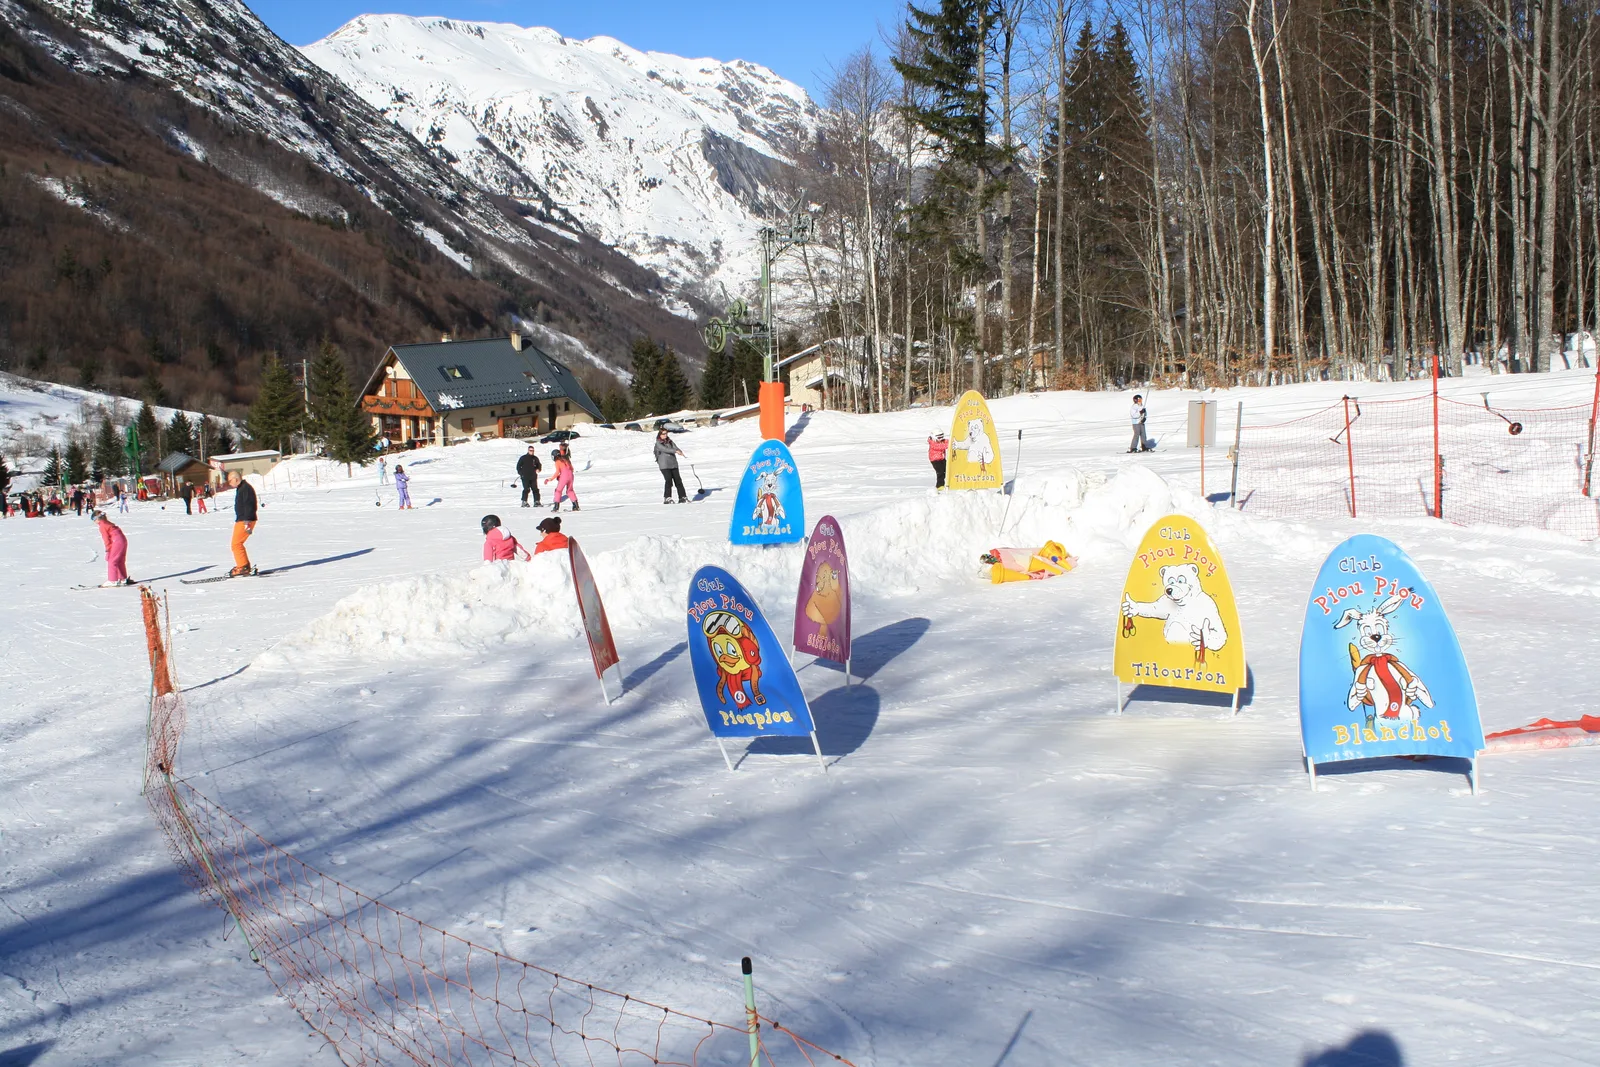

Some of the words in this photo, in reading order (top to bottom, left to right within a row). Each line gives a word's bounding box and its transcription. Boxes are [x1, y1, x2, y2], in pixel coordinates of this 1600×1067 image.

[763, 448, 781, 456] Club
[750, 459, 771, 474] Piou
[774, 457, 794, 474] Piou
[955, 474, 995, 482] Titourson
[742, 524, 792, 536] Blanchot
[1159, 527, 1191, 540] Club
[1138, 545, 1176, 569] Piou
[1183, 544, 1217, 575] Piou
[1338, 555, 1382, 573] Club
[697, 578, 724, 592] Club
[1313, 581, 1364, 615] Piou
[1374, 576, 1425, 611] Piou
[688, 597, 717, 622] Piou
[720, 593, 753, 621] Piou
[1131, 662, 1226, 685] Titourson
[719, 708, 793, 730] Pioupiou
[1332, 719, 1453, 745] Blanchot
